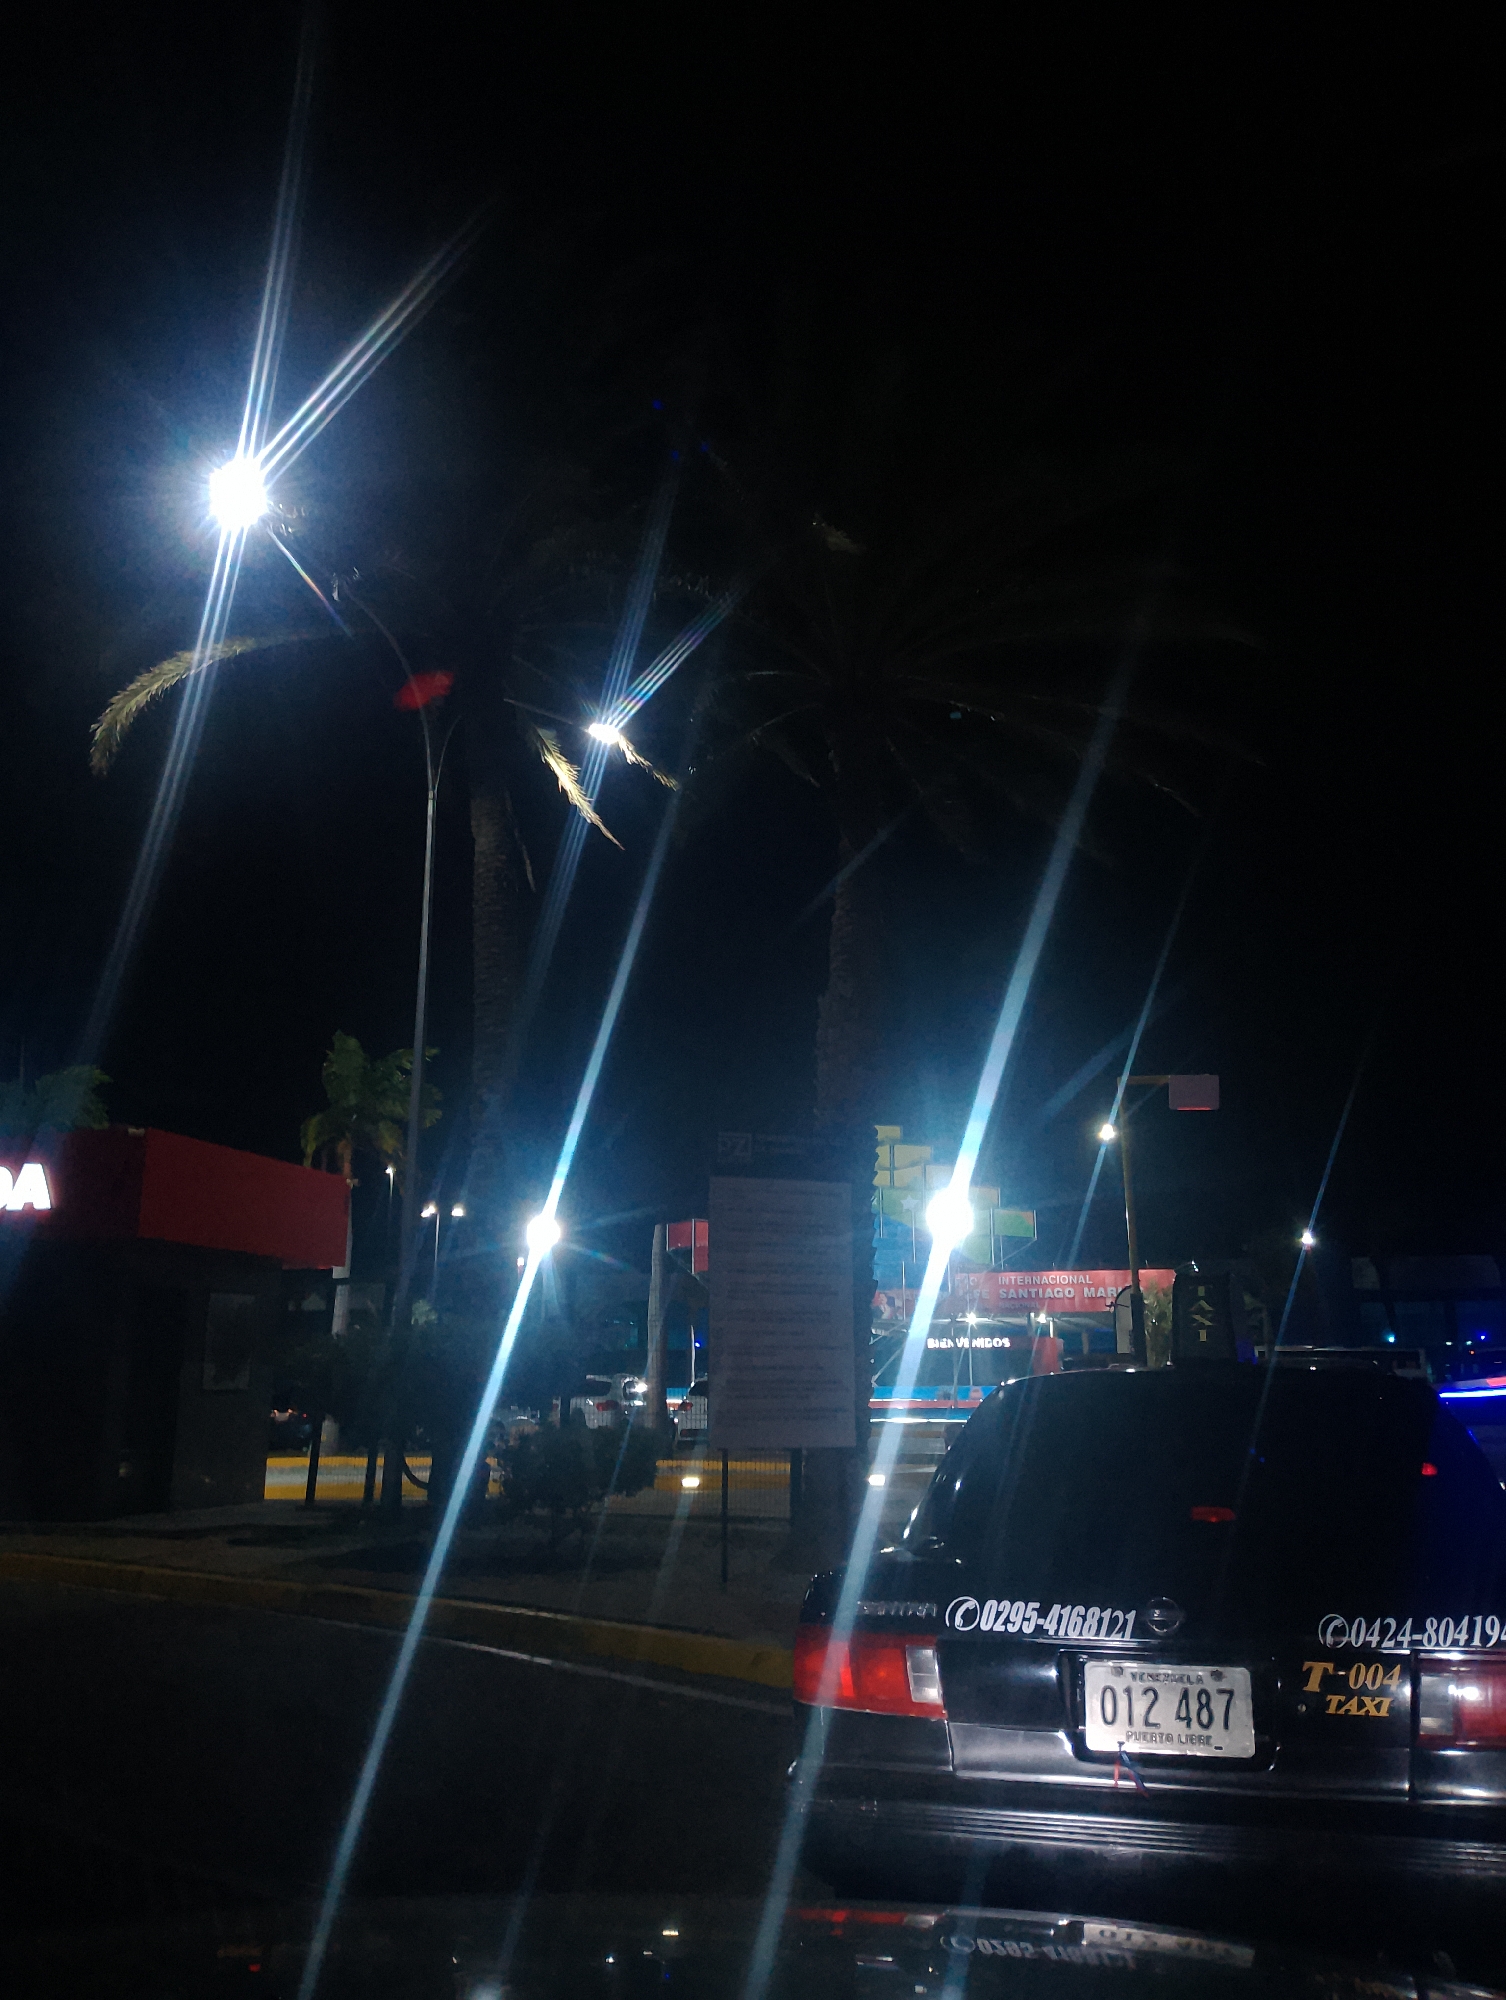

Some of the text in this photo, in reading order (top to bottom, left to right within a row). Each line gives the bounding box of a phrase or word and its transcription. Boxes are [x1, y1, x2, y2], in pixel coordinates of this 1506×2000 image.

[998, 1275, 1093, 1286] INTERNACIONAL
[999, 1287, 1075, 1299] SANTIAGO
[927, 1336, 1011, 1349] BIENVENIDOS
[979, 1599, 1137, 1640] 0295-4168121
[1350, 1614, 1506, 1648] 0424-80419
[1130, 1671, 1205, 1685] VENEZUELA
[1302, 1661, 1402, 1692] T-004
[1101, 1685, 1235, 1731] 012 487
[1325, 1694, 1394, 1717] TAXI
[1126, 1730, 1213, 1748] PUERTO LIBRE
